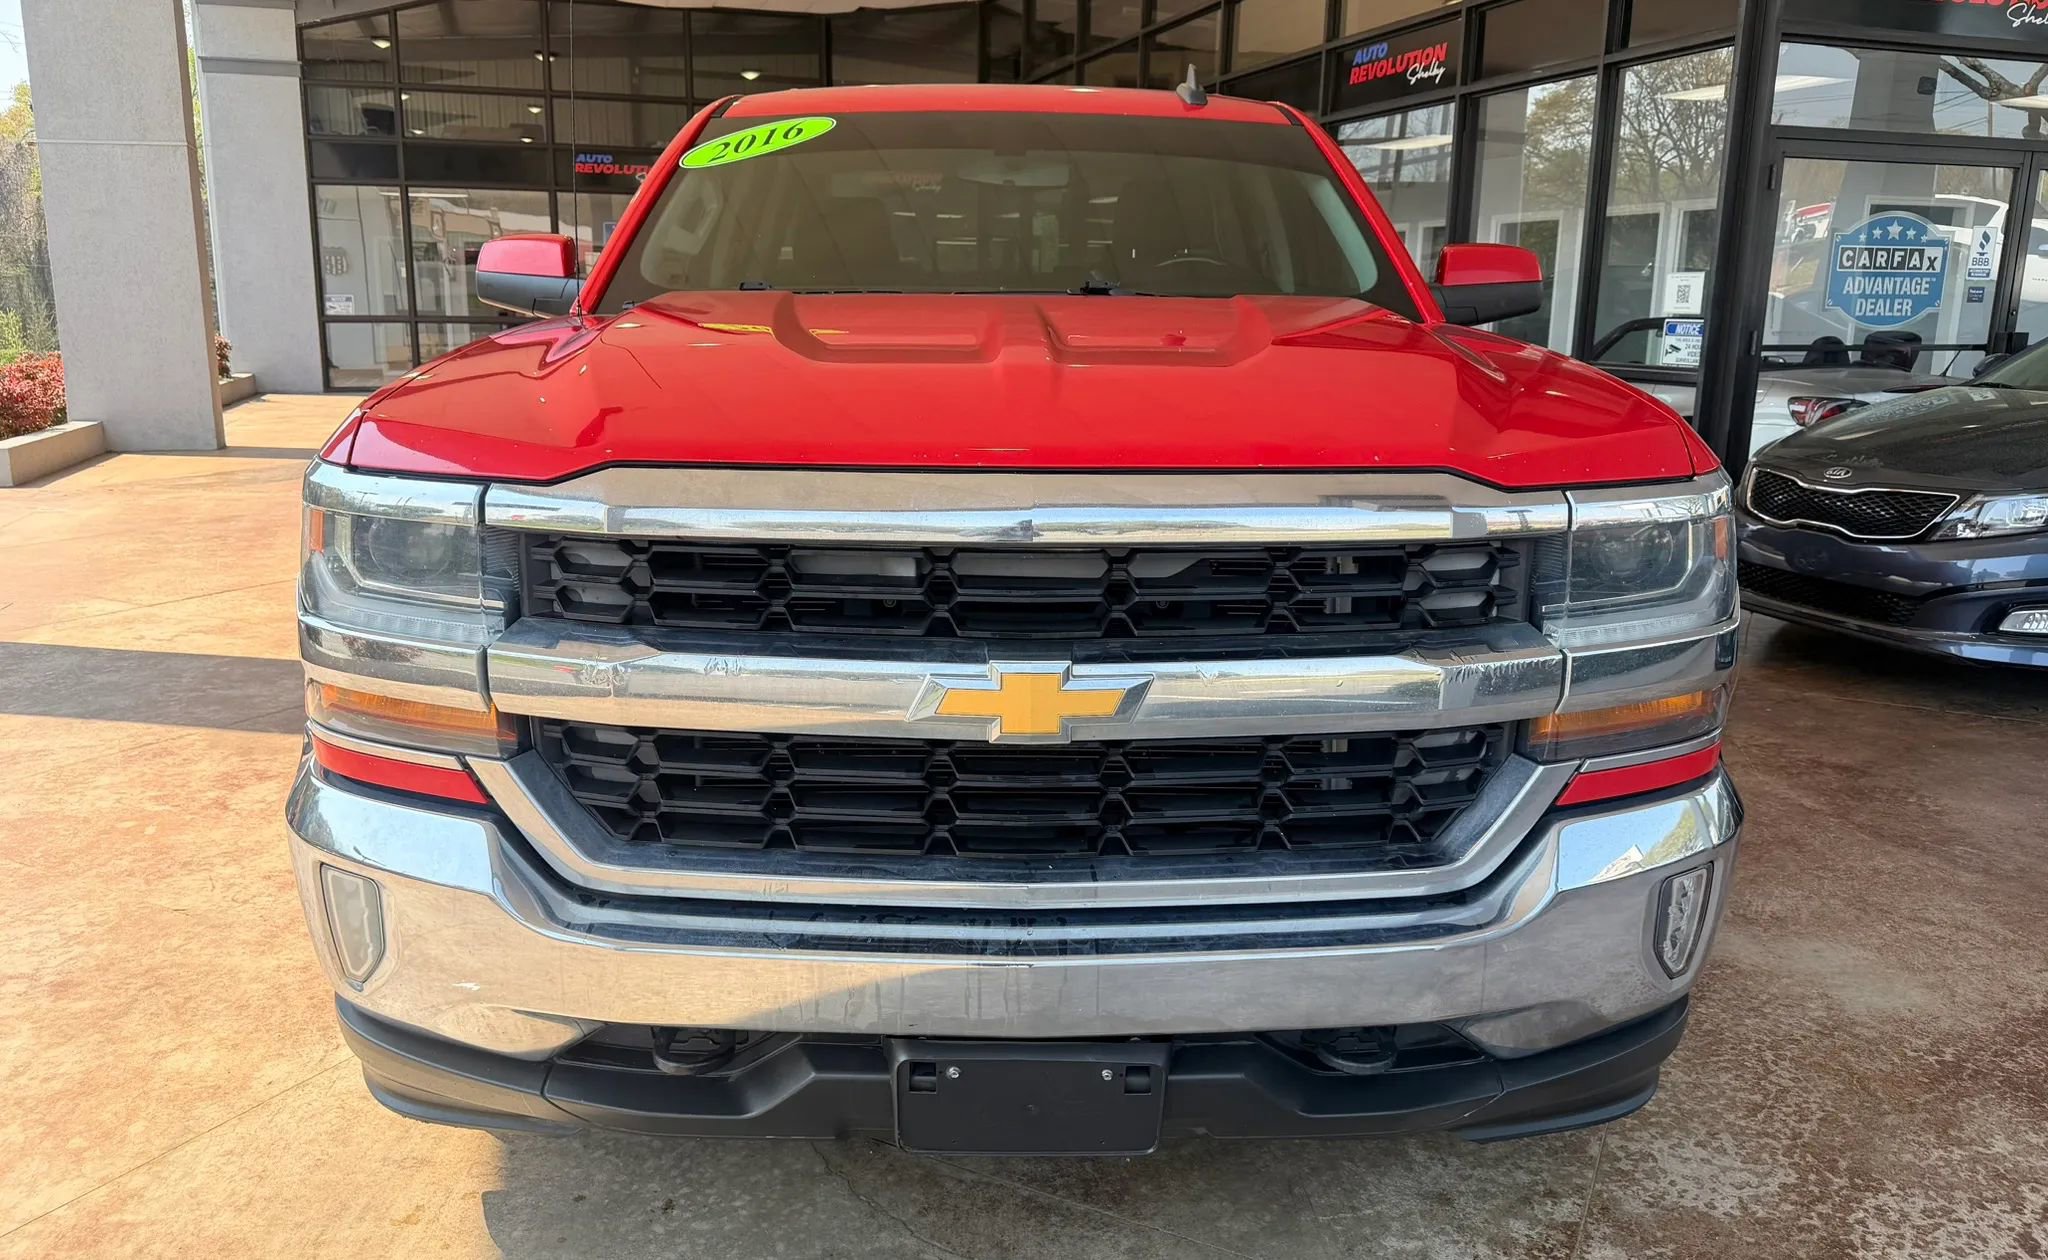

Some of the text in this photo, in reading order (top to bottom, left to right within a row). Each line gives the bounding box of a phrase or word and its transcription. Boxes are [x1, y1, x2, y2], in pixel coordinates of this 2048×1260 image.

[1349, 43, 1448, 84] REVOLUTION
[1353, 42, 1388, 65] AUTO
[1406, 58, 1446, 85] Shelby
[707, 120, 807, 163] 2016
[576, 153, 613, 164] AUTO
[1841, 250, 1939, 271] CARFAX
[1972, 257, 1990, 267] BBB
[1843, 276, 1931, 295] ADVANTAGE
[1855, 298, 1913, 317] DEALER
[1676, 323, 1701, 335] NOTICE
